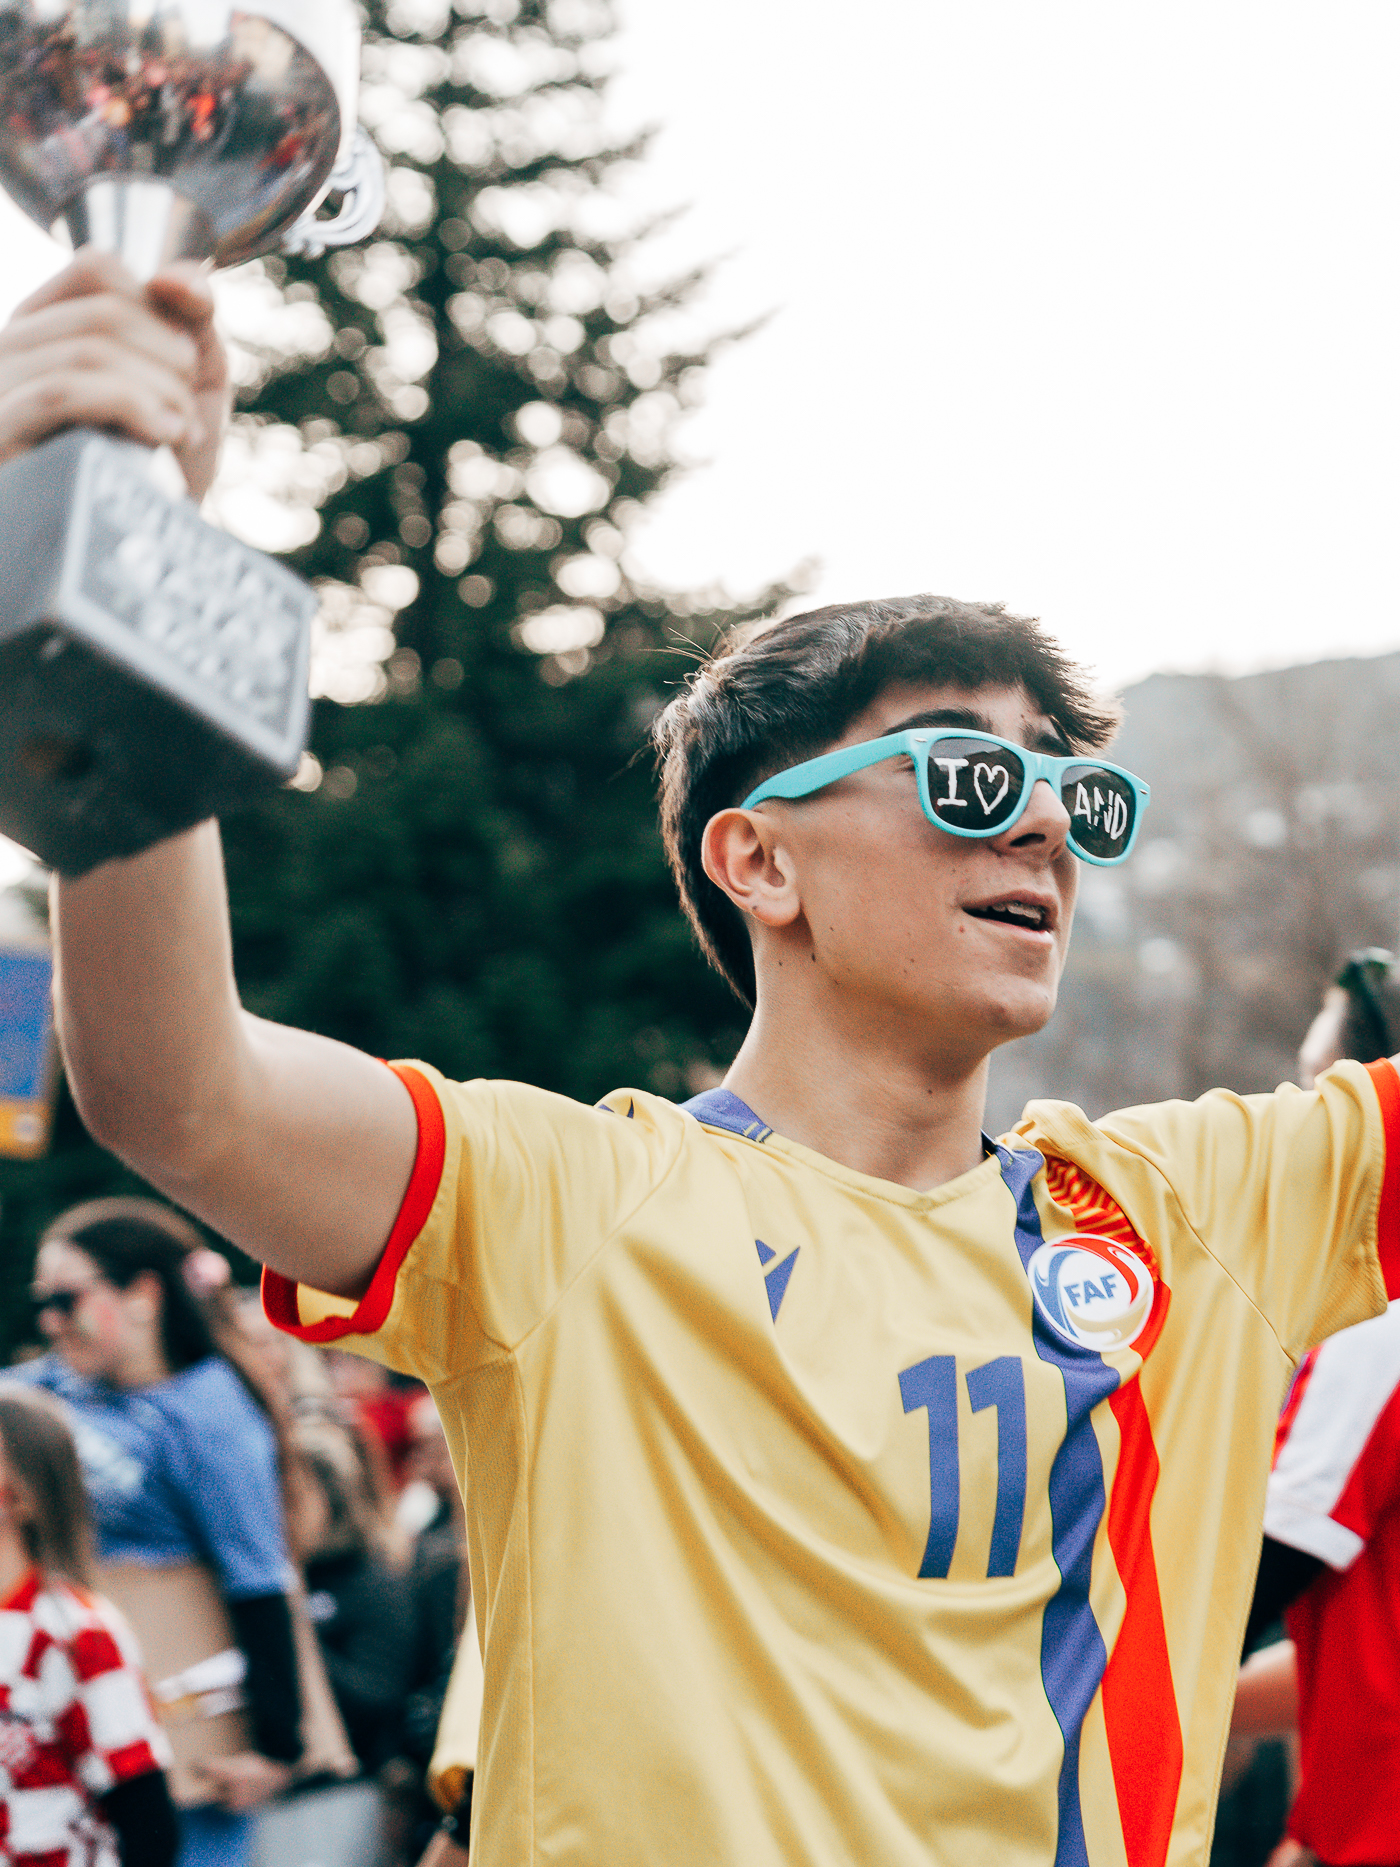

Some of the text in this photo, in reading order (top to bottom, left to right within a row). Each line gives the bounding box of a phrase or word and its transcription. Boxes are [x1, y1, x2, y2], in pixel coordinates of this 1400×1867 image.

[934, 757, 1128, 840] I AND
[1063, 1273, 1118, 1308] FAF
[897, 1354, 1028, 1580] 11
